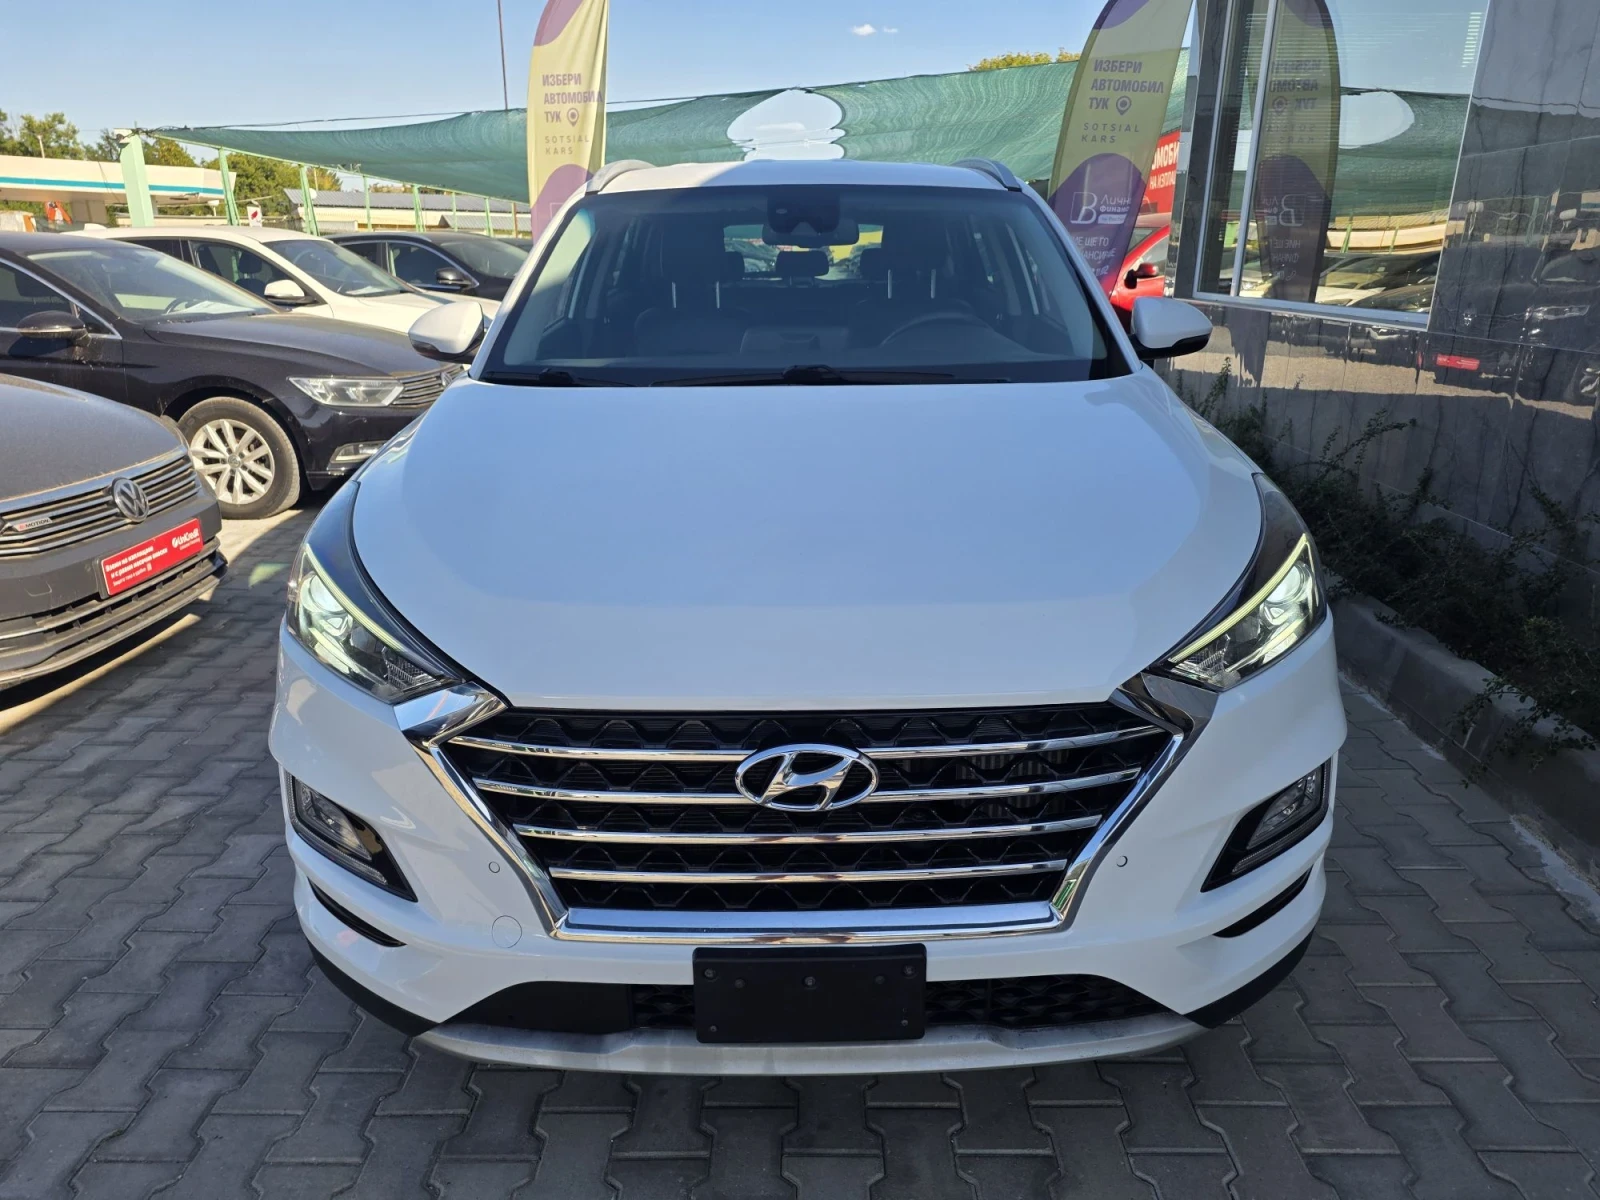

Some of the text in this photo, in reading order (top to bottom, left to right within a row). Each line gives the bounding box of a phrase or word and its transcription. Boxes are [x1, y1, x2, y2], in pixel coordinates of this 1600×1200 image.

[1093, 59, 1143, 74] ИЗБЕРИ
[542, 73, 582, 86] ИЗБЕРИ
[1091, 79, 1164, 93] АВТОМОБИЛ
[543, 90, 603, 105] АВТОМОБИЛ
[1089, 97, 1110, 110] ТУК
[544, 111, 562, 123] ТУК
[1083, 122, 1139, 132] SOTSIAL
[545, 134, 590, 144] SOTSIAL
[1081, 134, 1116, 144] KARS
[545, 147, 574, 155] KARS
